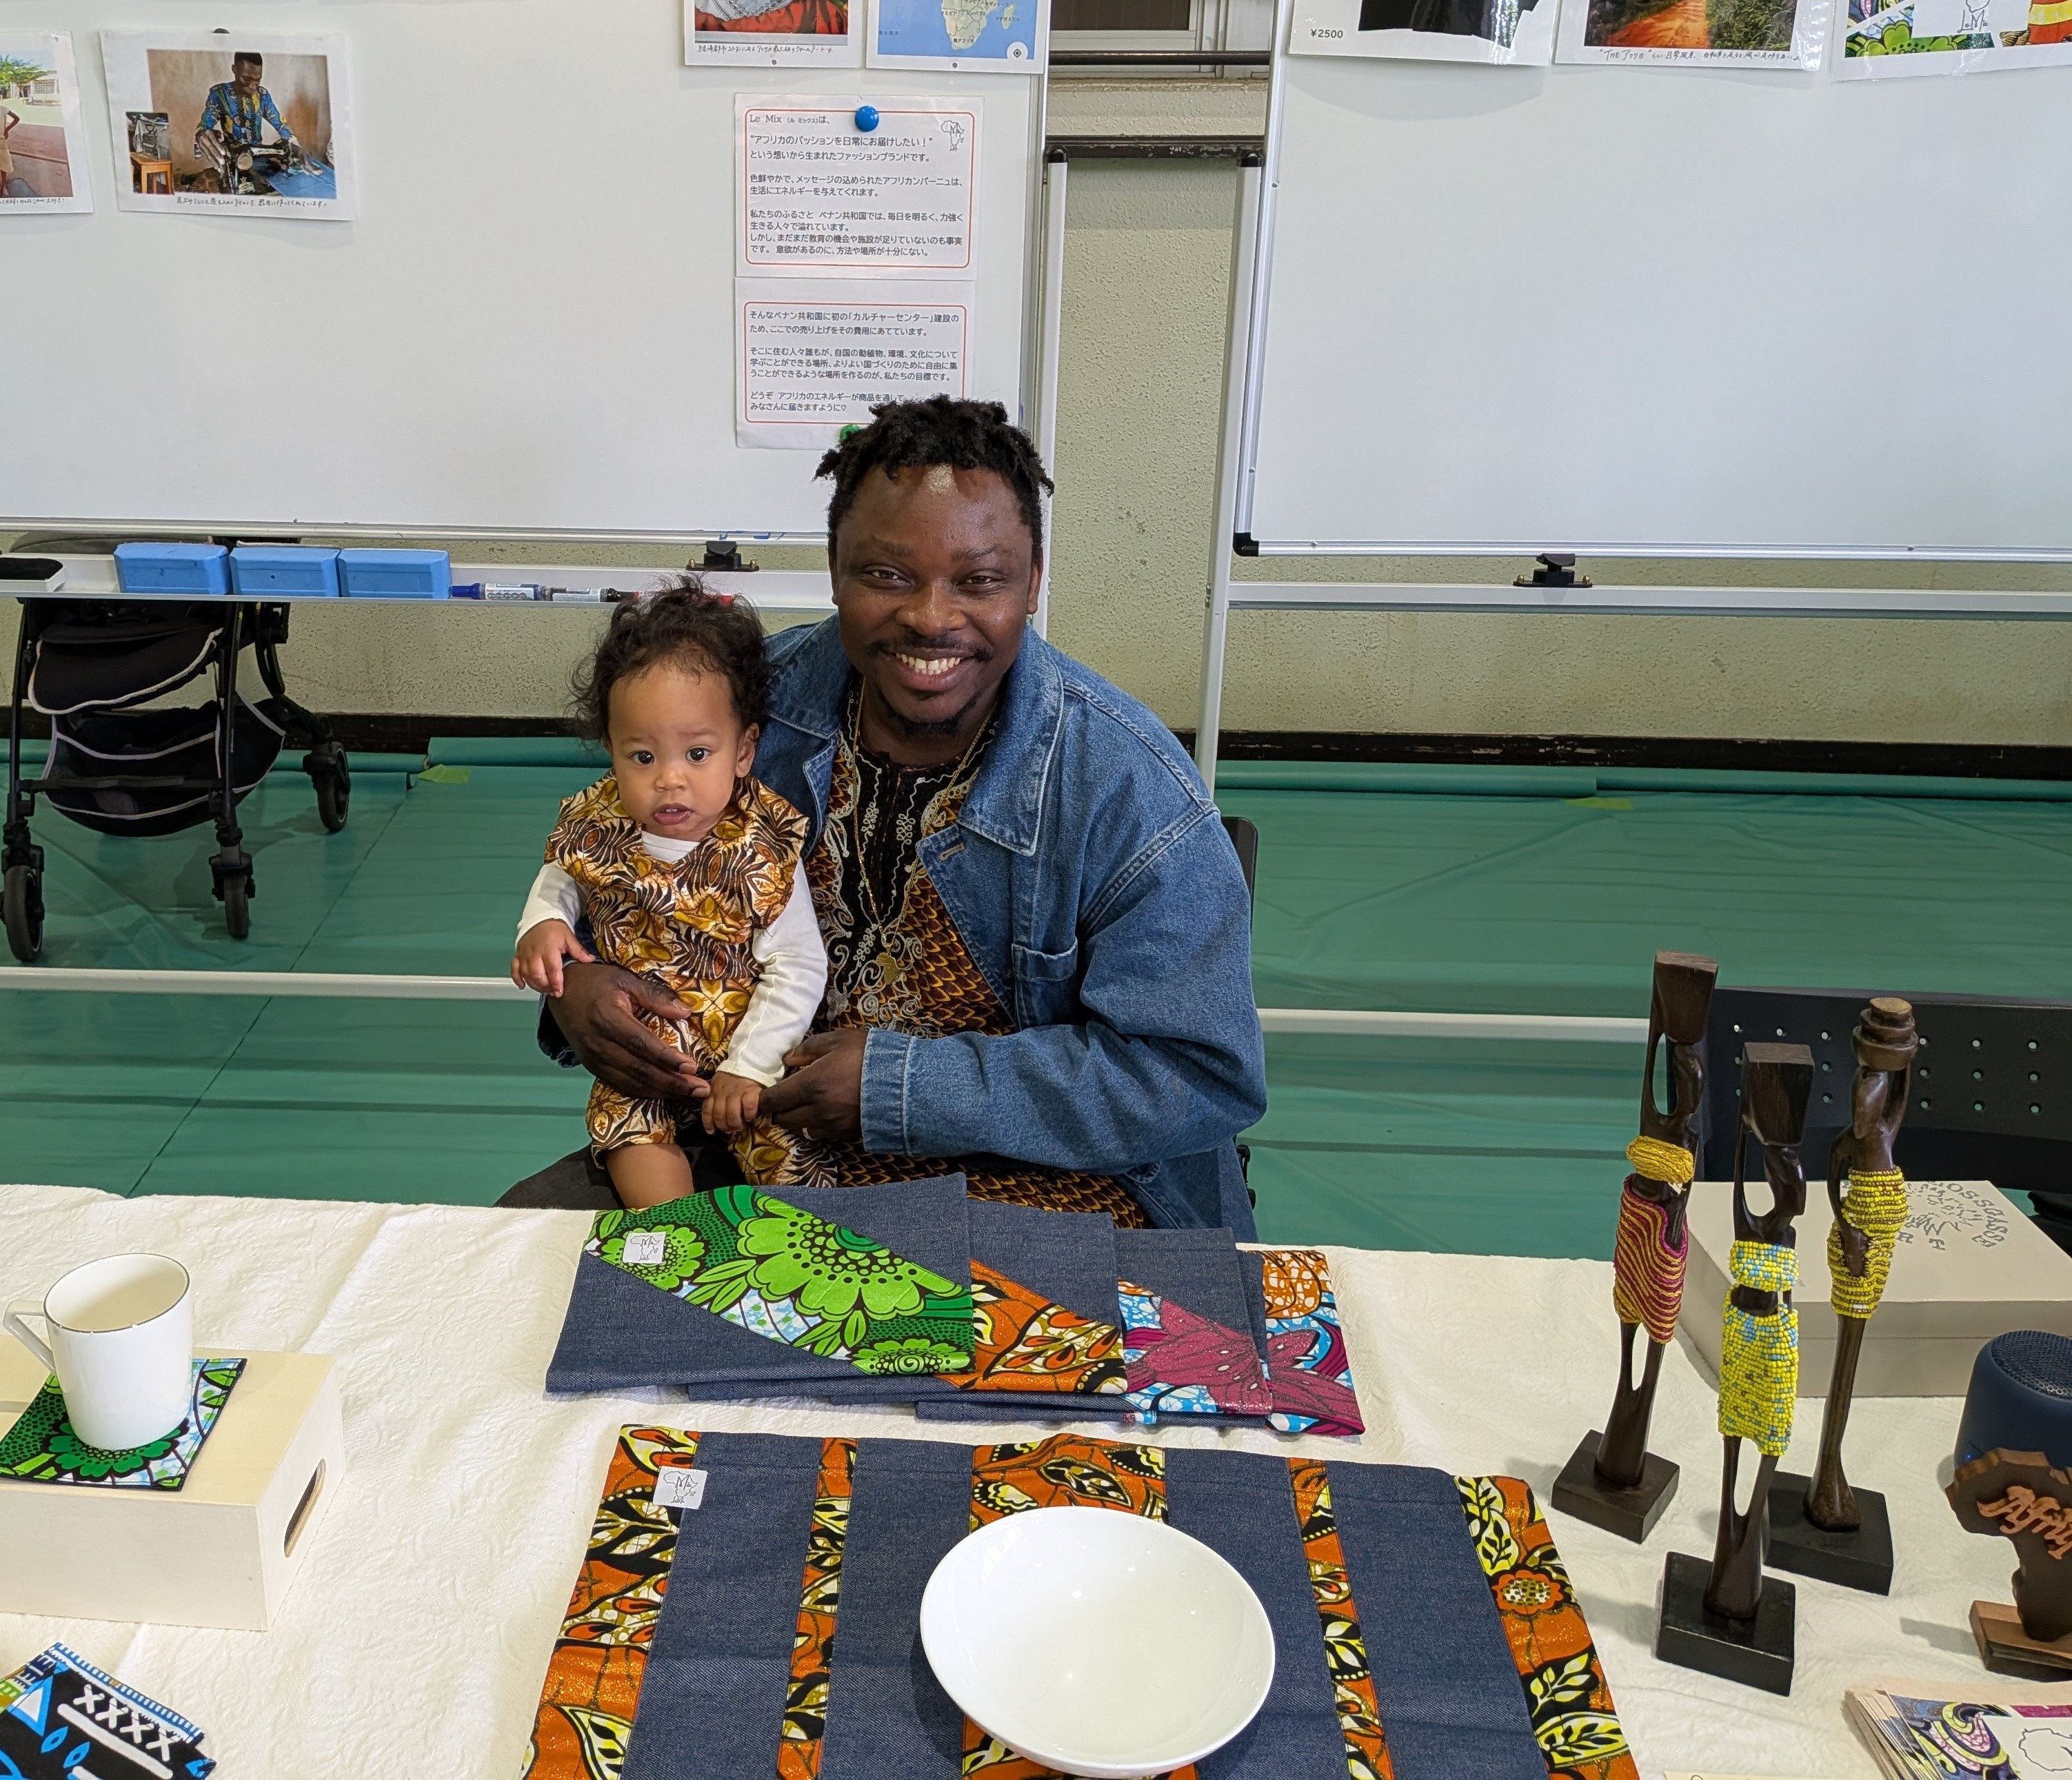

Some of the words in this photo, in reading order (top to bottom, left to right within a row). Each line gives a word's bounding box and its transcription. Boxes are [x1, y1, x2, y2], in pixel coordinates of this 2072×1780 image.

[1311, 29, 1343, 39] ¥2500
[749, 114, 761, 123] Le
[765, 114, 783, 123] Mix
